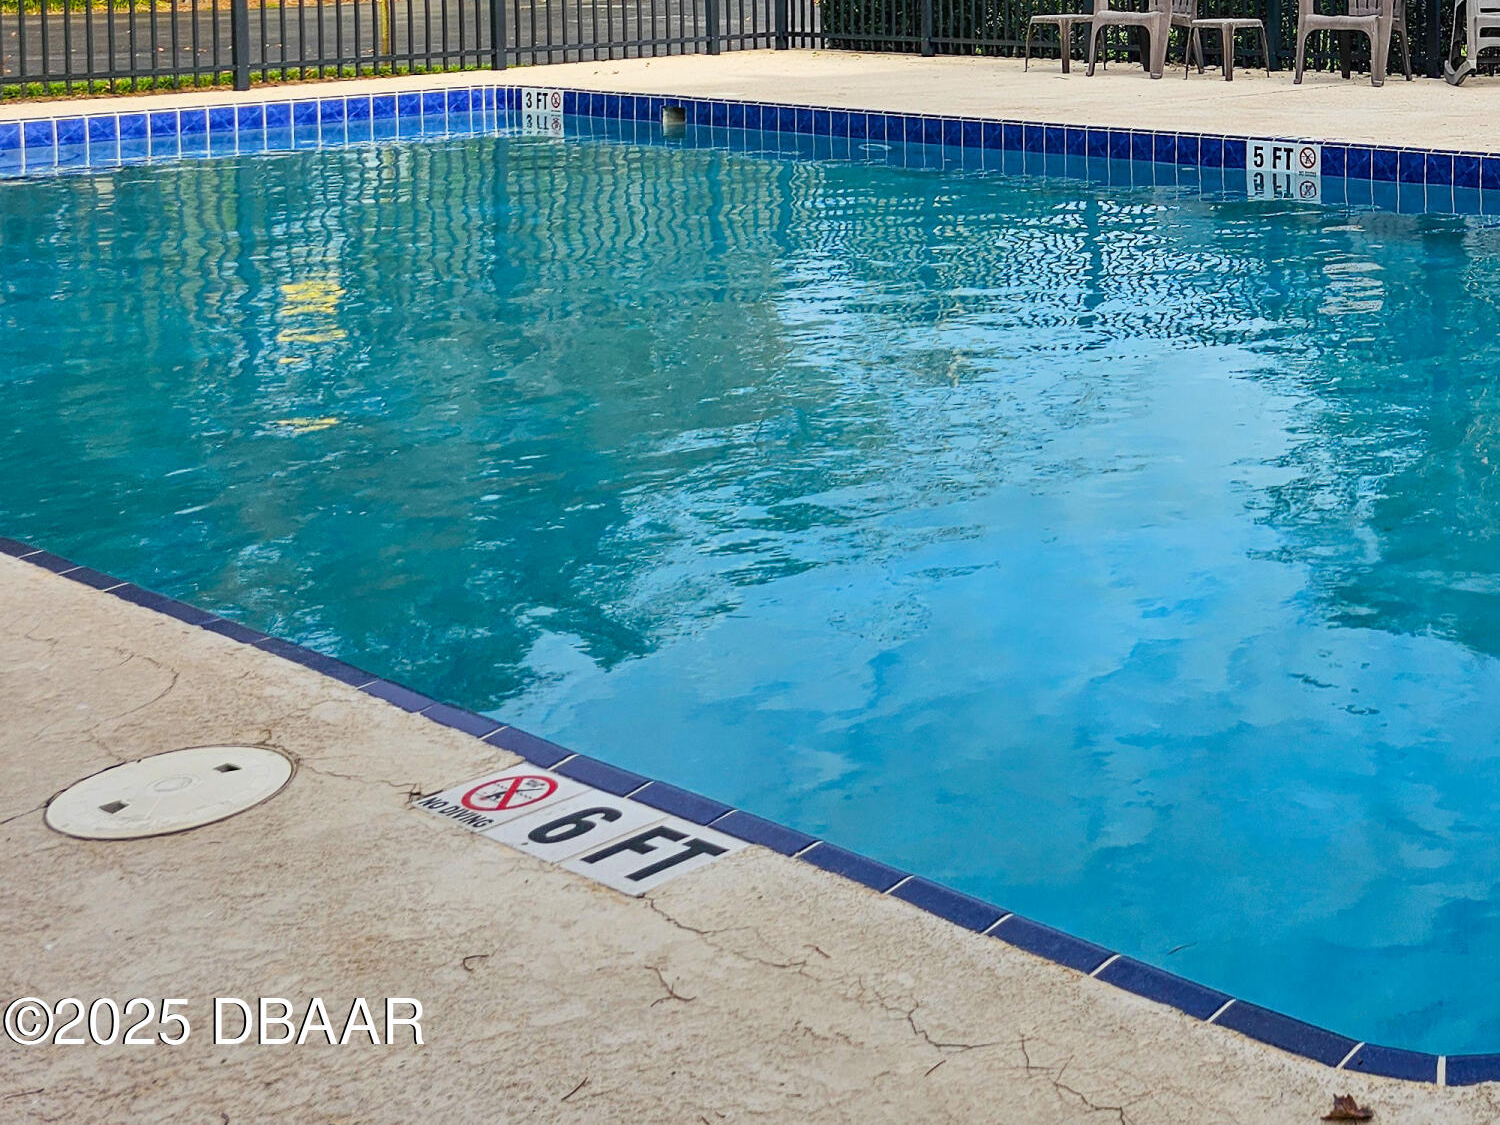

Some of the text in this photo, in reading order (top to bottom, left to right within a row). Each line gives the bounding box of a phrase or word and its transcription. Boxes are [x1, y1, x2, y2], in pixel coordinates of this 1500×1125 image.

[526, 92, 548, 110] 3 FT
[1254, 146, 1294, 170] 5 FT
[418, 796, 494, 828] NO DIVING
[528, 806, 731, 882] 6 FT
